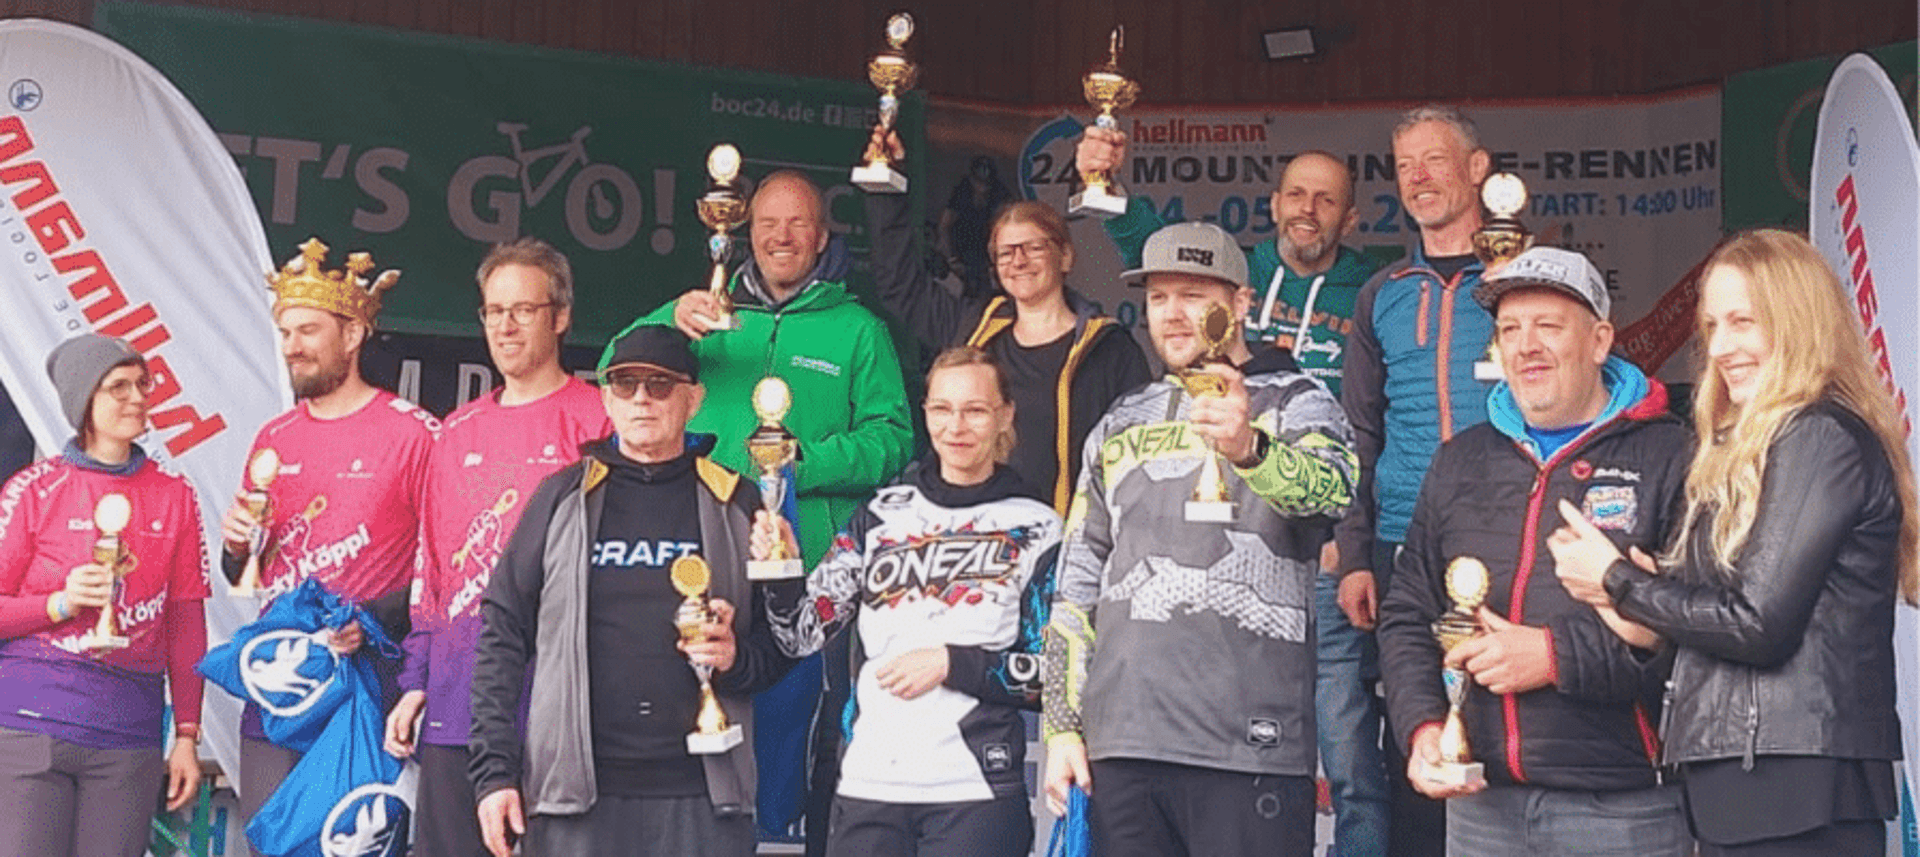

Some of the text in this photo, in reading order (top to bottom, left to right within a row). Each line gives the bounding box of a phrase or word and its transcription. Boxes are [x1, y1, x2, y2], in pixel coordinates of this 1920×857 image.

[711, 91, 815, 123] boc24.de
[1133, 119, 1267, 145] hellmann
[1528, 192, 1605, 218] TART:
[1682, 185, 1715, 211] Uhr
[298, 523, 371, 580] Köppl
[867, 540, 1012, 594] ONEAL
